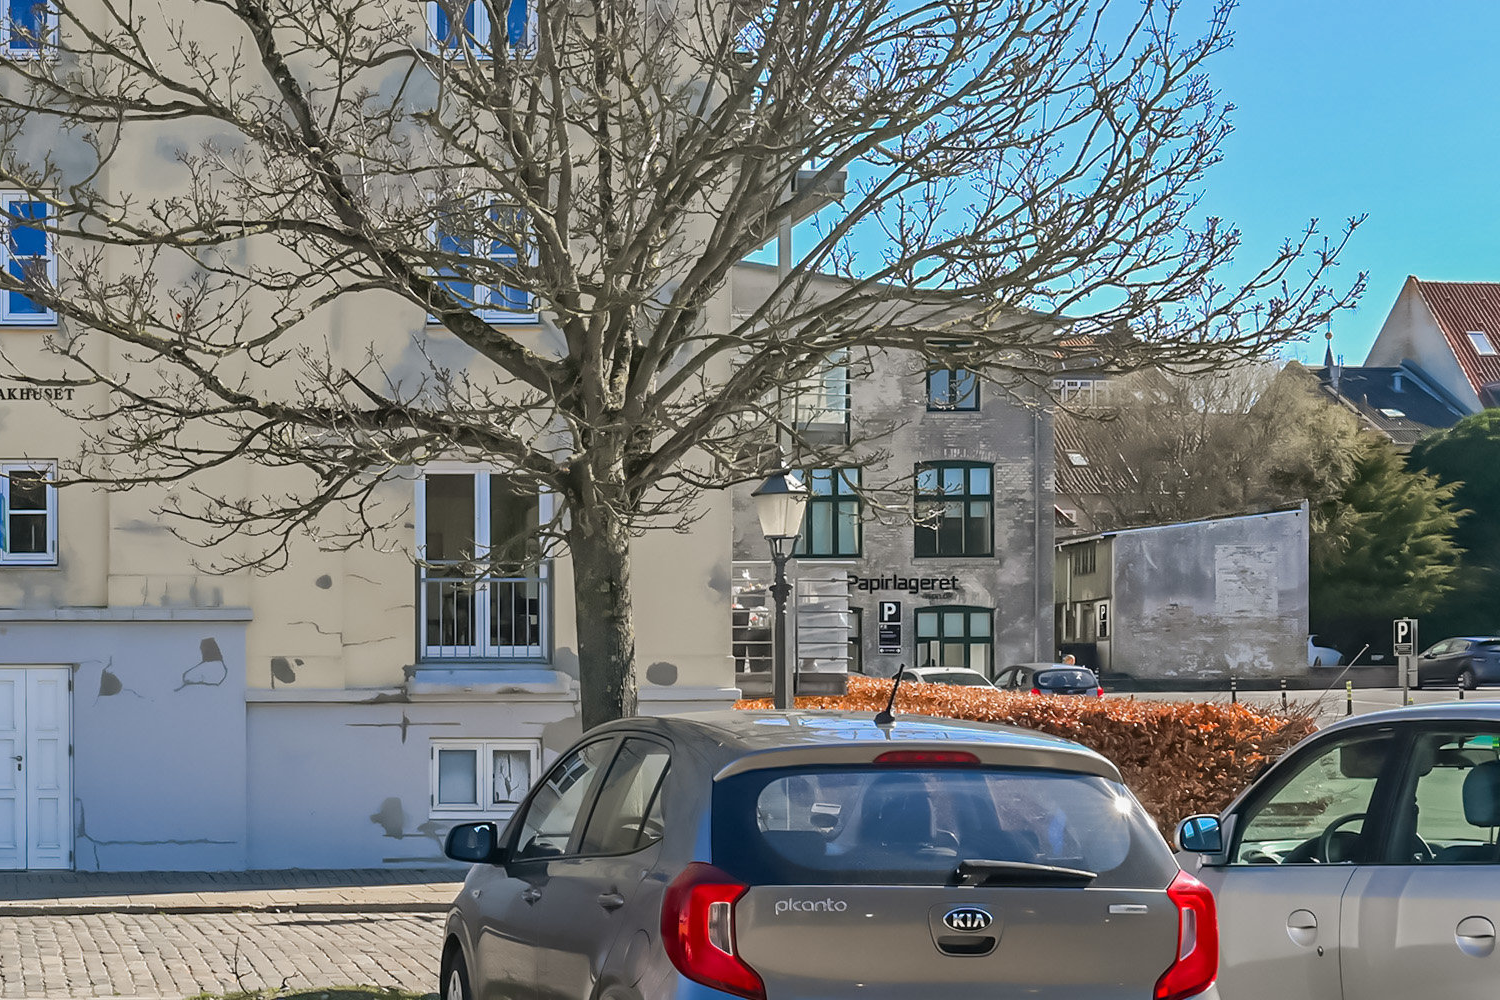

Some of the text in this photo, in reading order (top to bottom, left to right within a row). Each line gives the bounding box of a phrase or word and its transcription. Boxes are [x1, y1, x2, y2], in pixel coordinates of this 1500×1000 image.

[847, 574, 959, 594] Papirlageret
[883, 602, 897, 621] P
[1100, 605, 1106, 620] P
[1397, 621, 1408, 643] P
[775, 897, 848, 916] picanto
[952, 913, 986, 928] KIA
